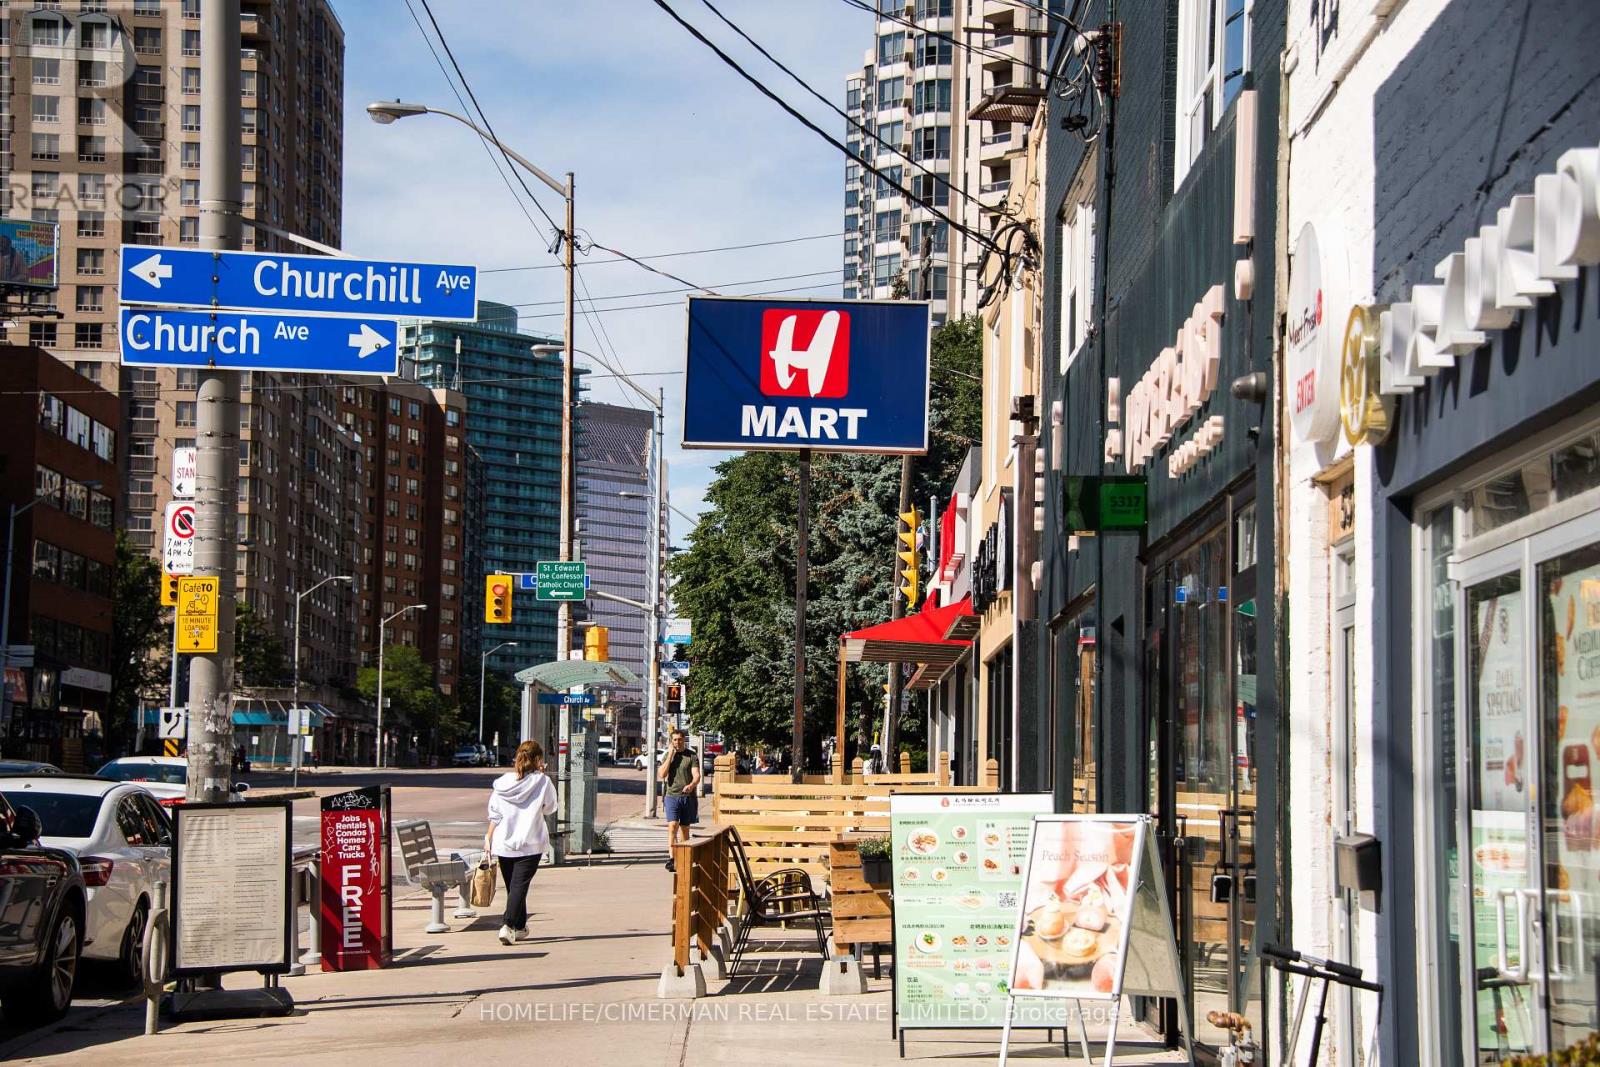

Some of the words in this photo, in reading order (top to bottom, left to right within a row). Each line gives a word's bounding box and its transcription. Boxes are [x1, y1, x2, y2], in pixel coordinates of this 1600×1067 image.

[253, 259, 422, 304] Churchill
[436, 270, 471, 290] Ave
[126, 314, 260, 355] Church
[273, 321, 309, 340] Ave
[768, 310, 841, 398] H
[1296, 368, 1316, 414] ENTER
[741, 404, 868, 440] MART
[188, 452, 197, 464] N
[1110, 495, 1141, 507] 5317
[167, 538, 173, 547] 7
[188, 538, 193, 547] 9
[167, 548, 172, 557] 4
[187, 548, 193, 557] 6
[551, 572, 583, 580] Confessor
[563, 695, 584, 704] Church
[341, 814, 360, 822] Jobs
[335, 822, 367, 830] Rentals
[335, 829, 367, 837] Condos
[342, 844, 361, 852] Cars
[338, 851, 366, 859] Trucks
[1042, 849, 1071, 862] Peach
[1074, 848, 1110, 863] Season
[341, 864, 363, 948] FREE
